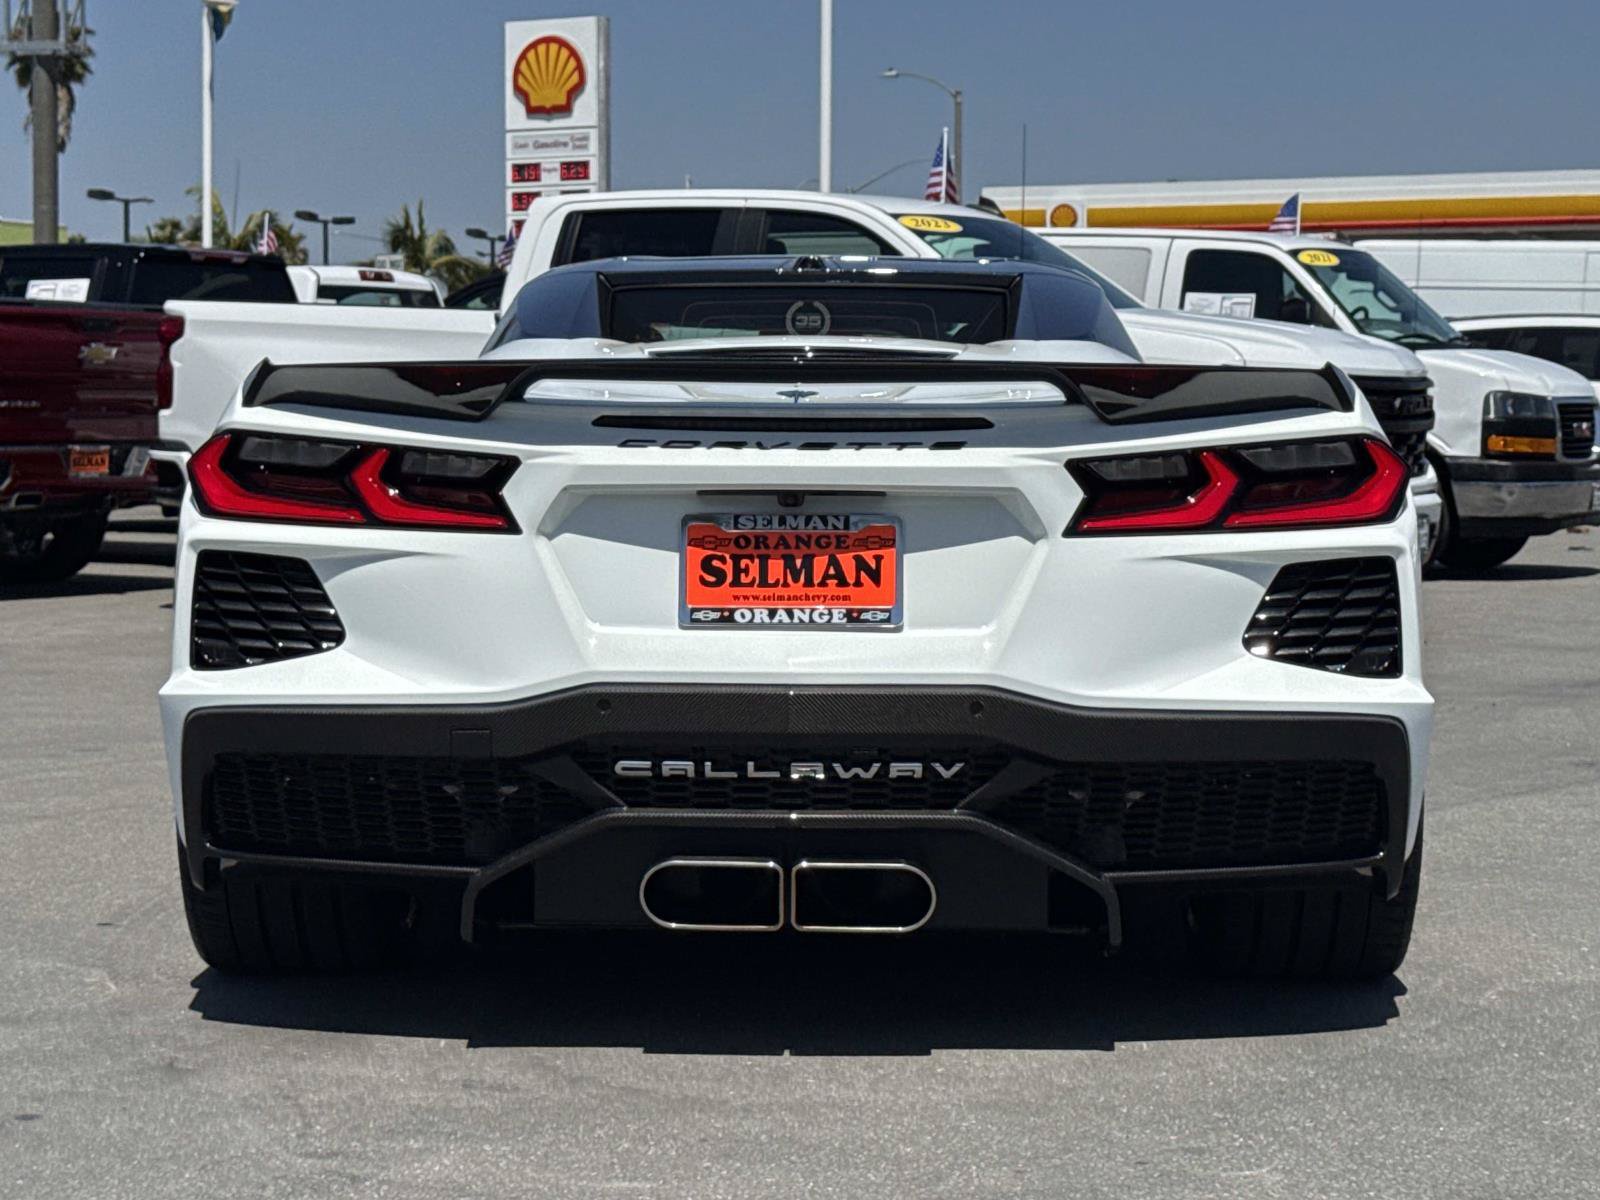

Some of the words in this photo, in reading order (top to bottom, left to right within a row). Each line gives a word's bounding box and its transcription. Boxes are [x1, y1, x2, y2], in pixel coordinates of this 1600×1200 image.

[532, 139, 569, 150] Gasoline
[909, 218, 952, 229] 2023
[1306, 253, 1332, 263] 2021
[795, 315, 821, 326] 35
[616, 439, 968, 451] CORVETTE
[737, 515, 845, 531] SELMAN
[733, 534, 850, 550] ORANGE
[698, 553, 885, 588] SELMAN
[732, 592, 852, 603] www.selmanchevy.com
[733, 608, 848, 624] ORANGE
[613, 760, 966, 779] CALLAWAY
